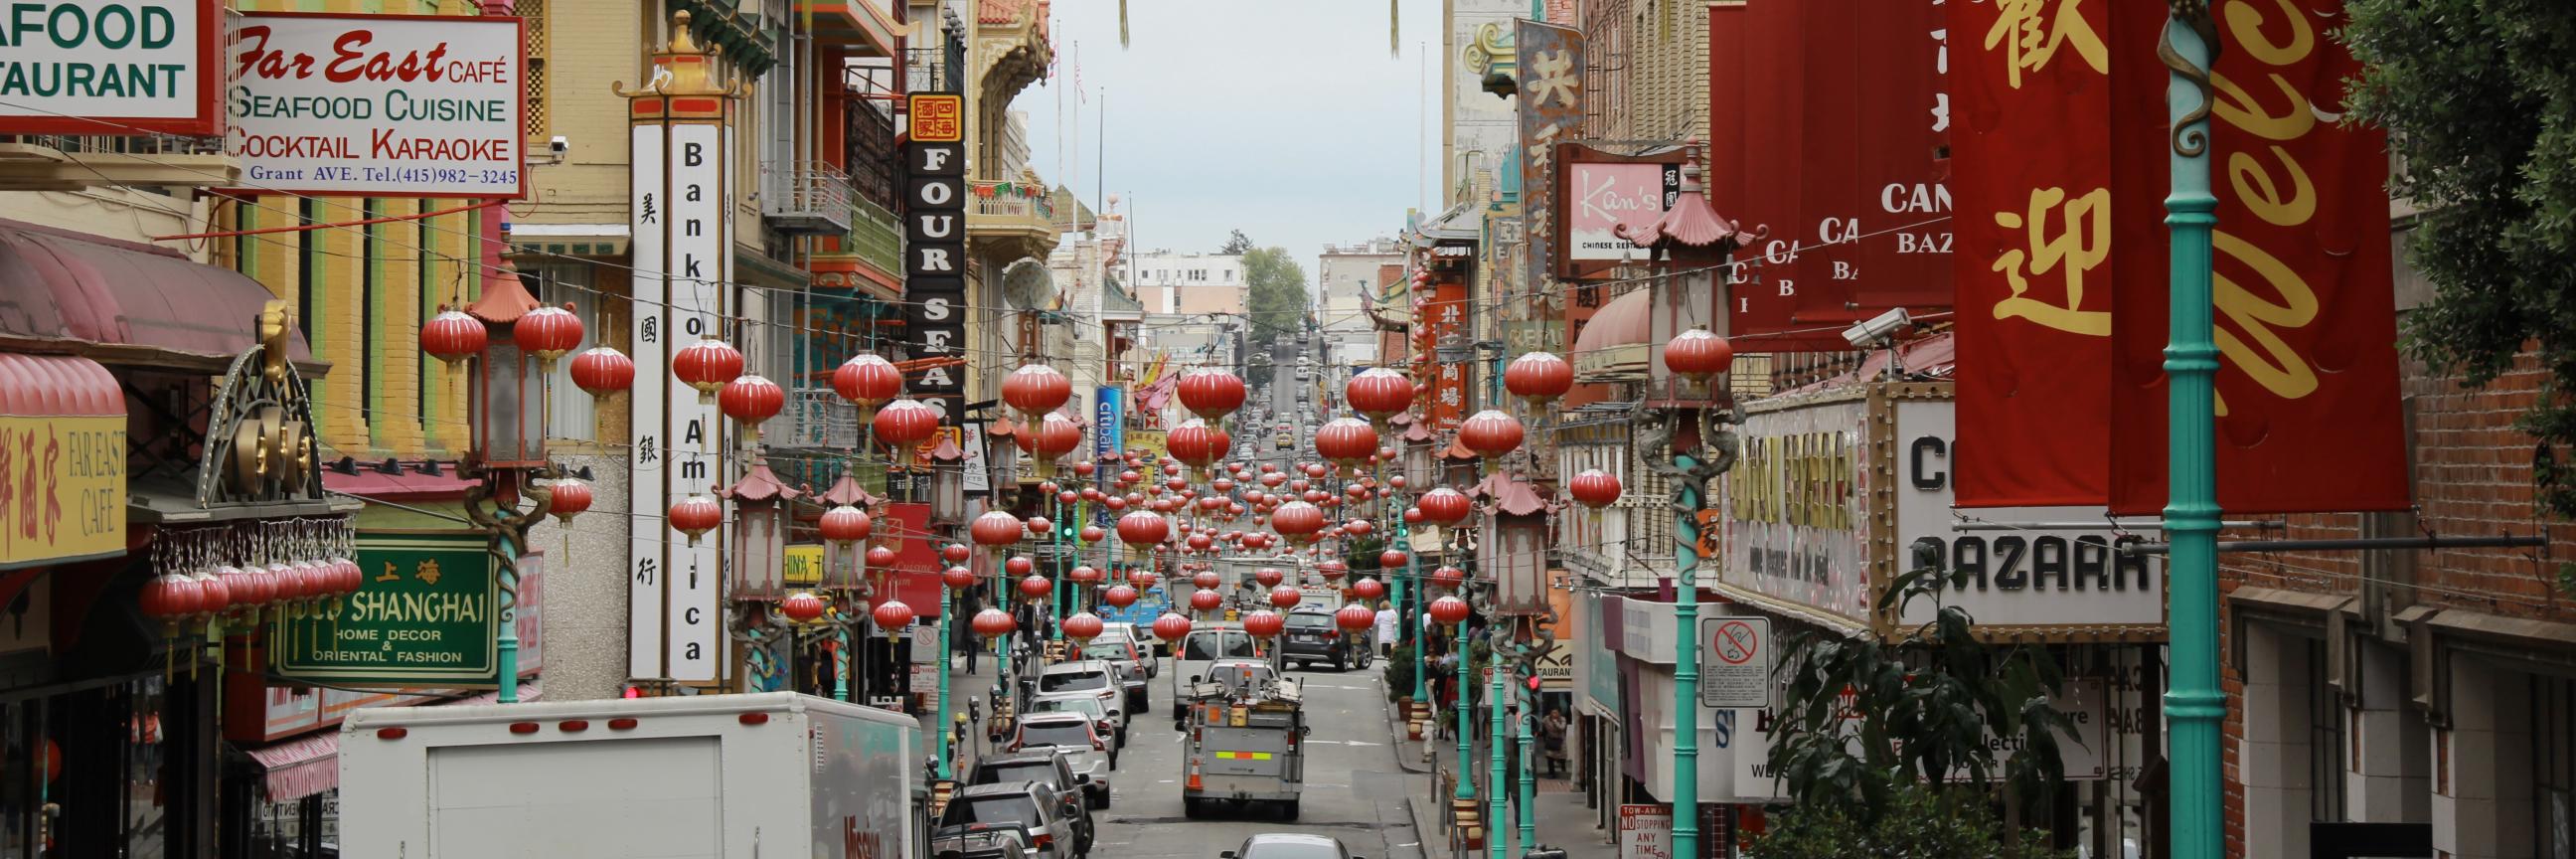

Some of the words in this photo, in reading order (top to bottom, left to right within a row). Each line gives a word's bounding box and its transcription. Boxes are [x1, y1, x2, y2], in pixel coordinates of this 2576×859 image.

[0, 3, 175, 50] AFOOD
[228, 25, 315, 84] Far
[325, 30, 447, 84] East
[448, 56, 507, 84] CAFÉ
[0, 62, 186, 97] AURANT
[228, 86, 372, 119] SEAFOOD
[385, 88, 506, 121] CUISINE
[226, 125, 360, 159] COCKTAIL
[372, 128, 509, 161] KARAOKE
[250, 166, 303, 181] Grant
[314, 167, 358, 181] AVE.
[685, 142, 703, 277] Bank
[921, 148, 952, 271] FOUR
[1579, 169, 1658, 223] Kan's
[1099, 402, 1111, 456] citiban
[69, 431, 92, 478] FAR
[95, 430, 126, 477] EAST
[81, 478, 113, 537] CAFÉ
[682, 420, 705, 660] Amica
[376, 558, 441, 585] 上海
[351, 592, 484, 622] SHANGHAI
[336, 629, 379, 641] HOME
[388, 629, 441, 641] DECOR
[382, 640, 393, 651] &
[312, 650, 388, 662] ORIENTAL
[398, 651, 462, 663] FASHION
[1622, 815, 1635, 829] NO
[1636, 819, 1670, 829] STOPPING
[1637, 833, 1656, 842] ANY
[1635, 844, 1657, 855] TIME
